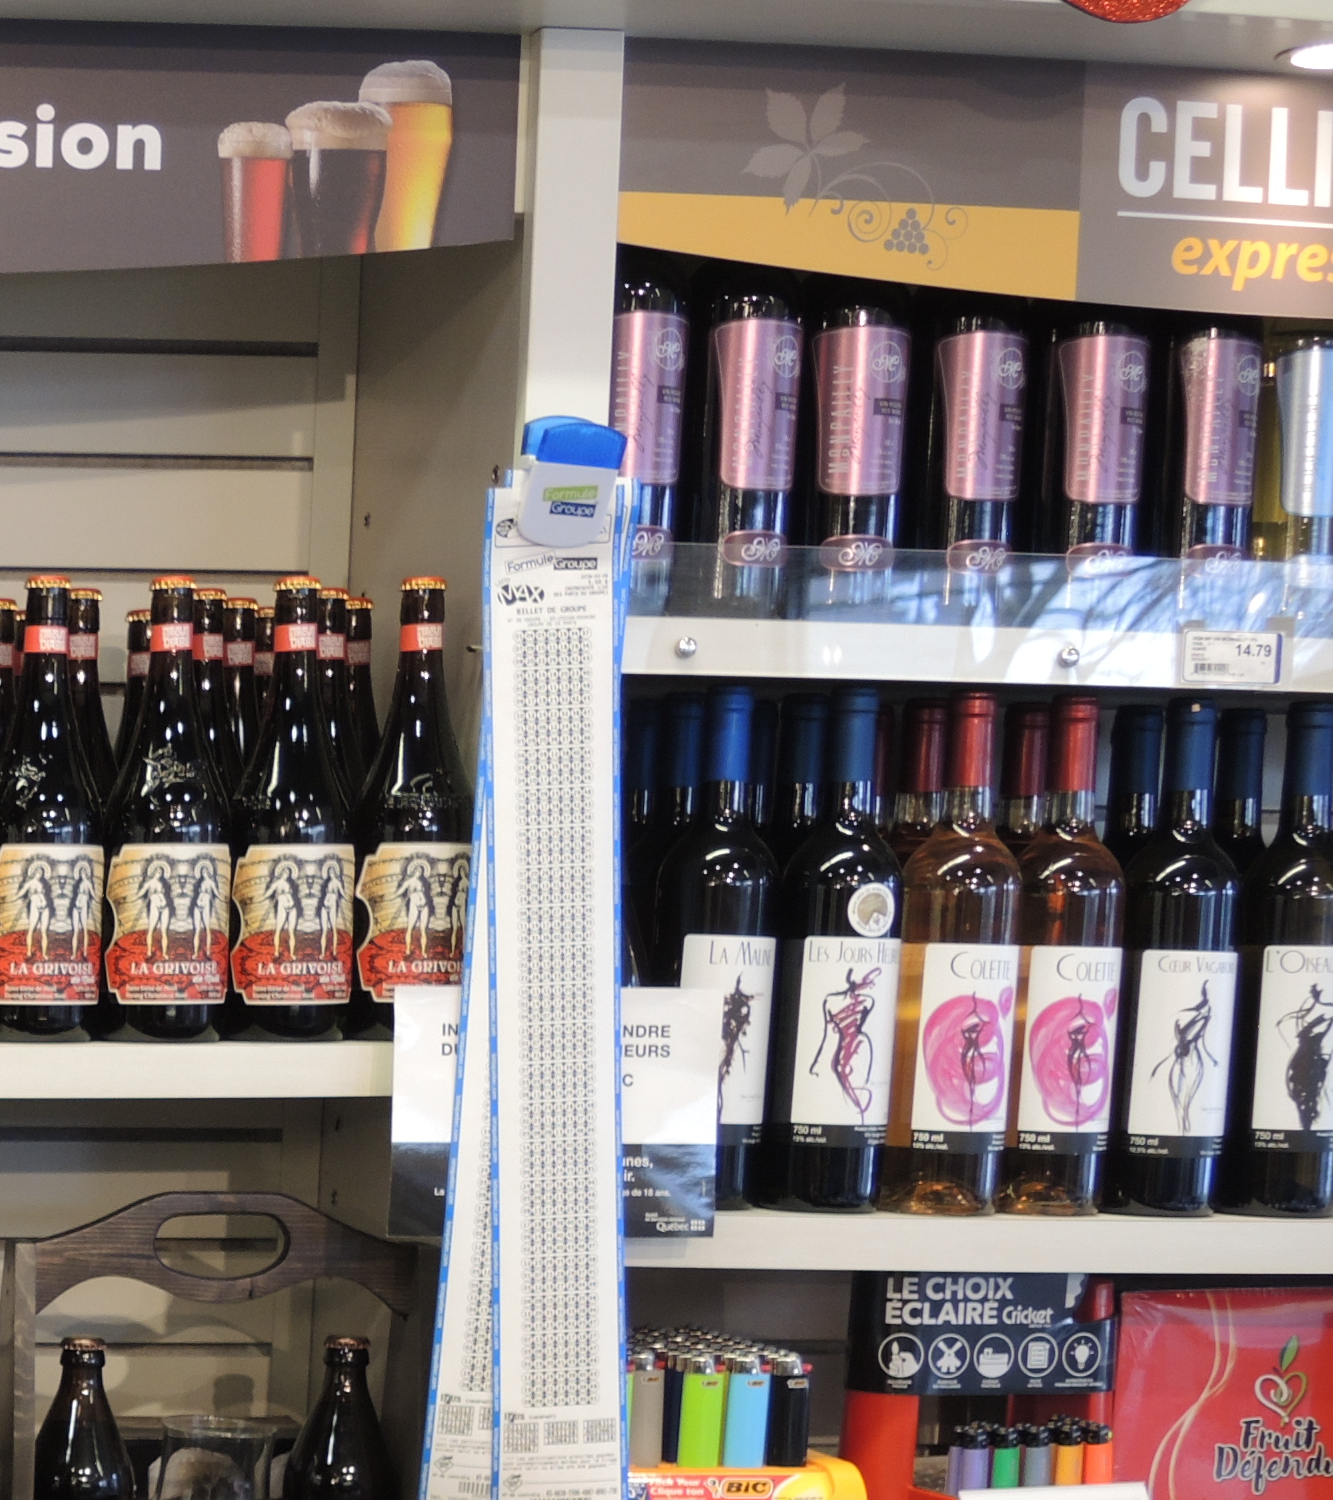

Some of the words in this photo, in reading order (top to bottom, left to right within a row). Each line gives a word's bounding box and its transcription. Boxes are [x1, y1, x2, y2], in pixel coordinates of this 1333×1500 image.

[543, 486, 597, 500] Formule
[551, 501, 595, 517] Groupe
[507, 554, 555, 574] Formule
[554, 558, 598, 570] Groupe
[1235, 643, 1272, 657] 14.79
[709, 939, 729, 965] LA
[130, 961, 150, 975] LA
[152, 961, 217, 976] GRIVOISE
[886, 1276, 921, 1300] LE
[924, 1276, 1014, 1299] CHOIX
[885, 1299, 999, 1326] ÉCLAIRÉ
[1001, 1304, 1054, 1326] Cricket
[1240, 1417, 1321, 1452] Fruit
